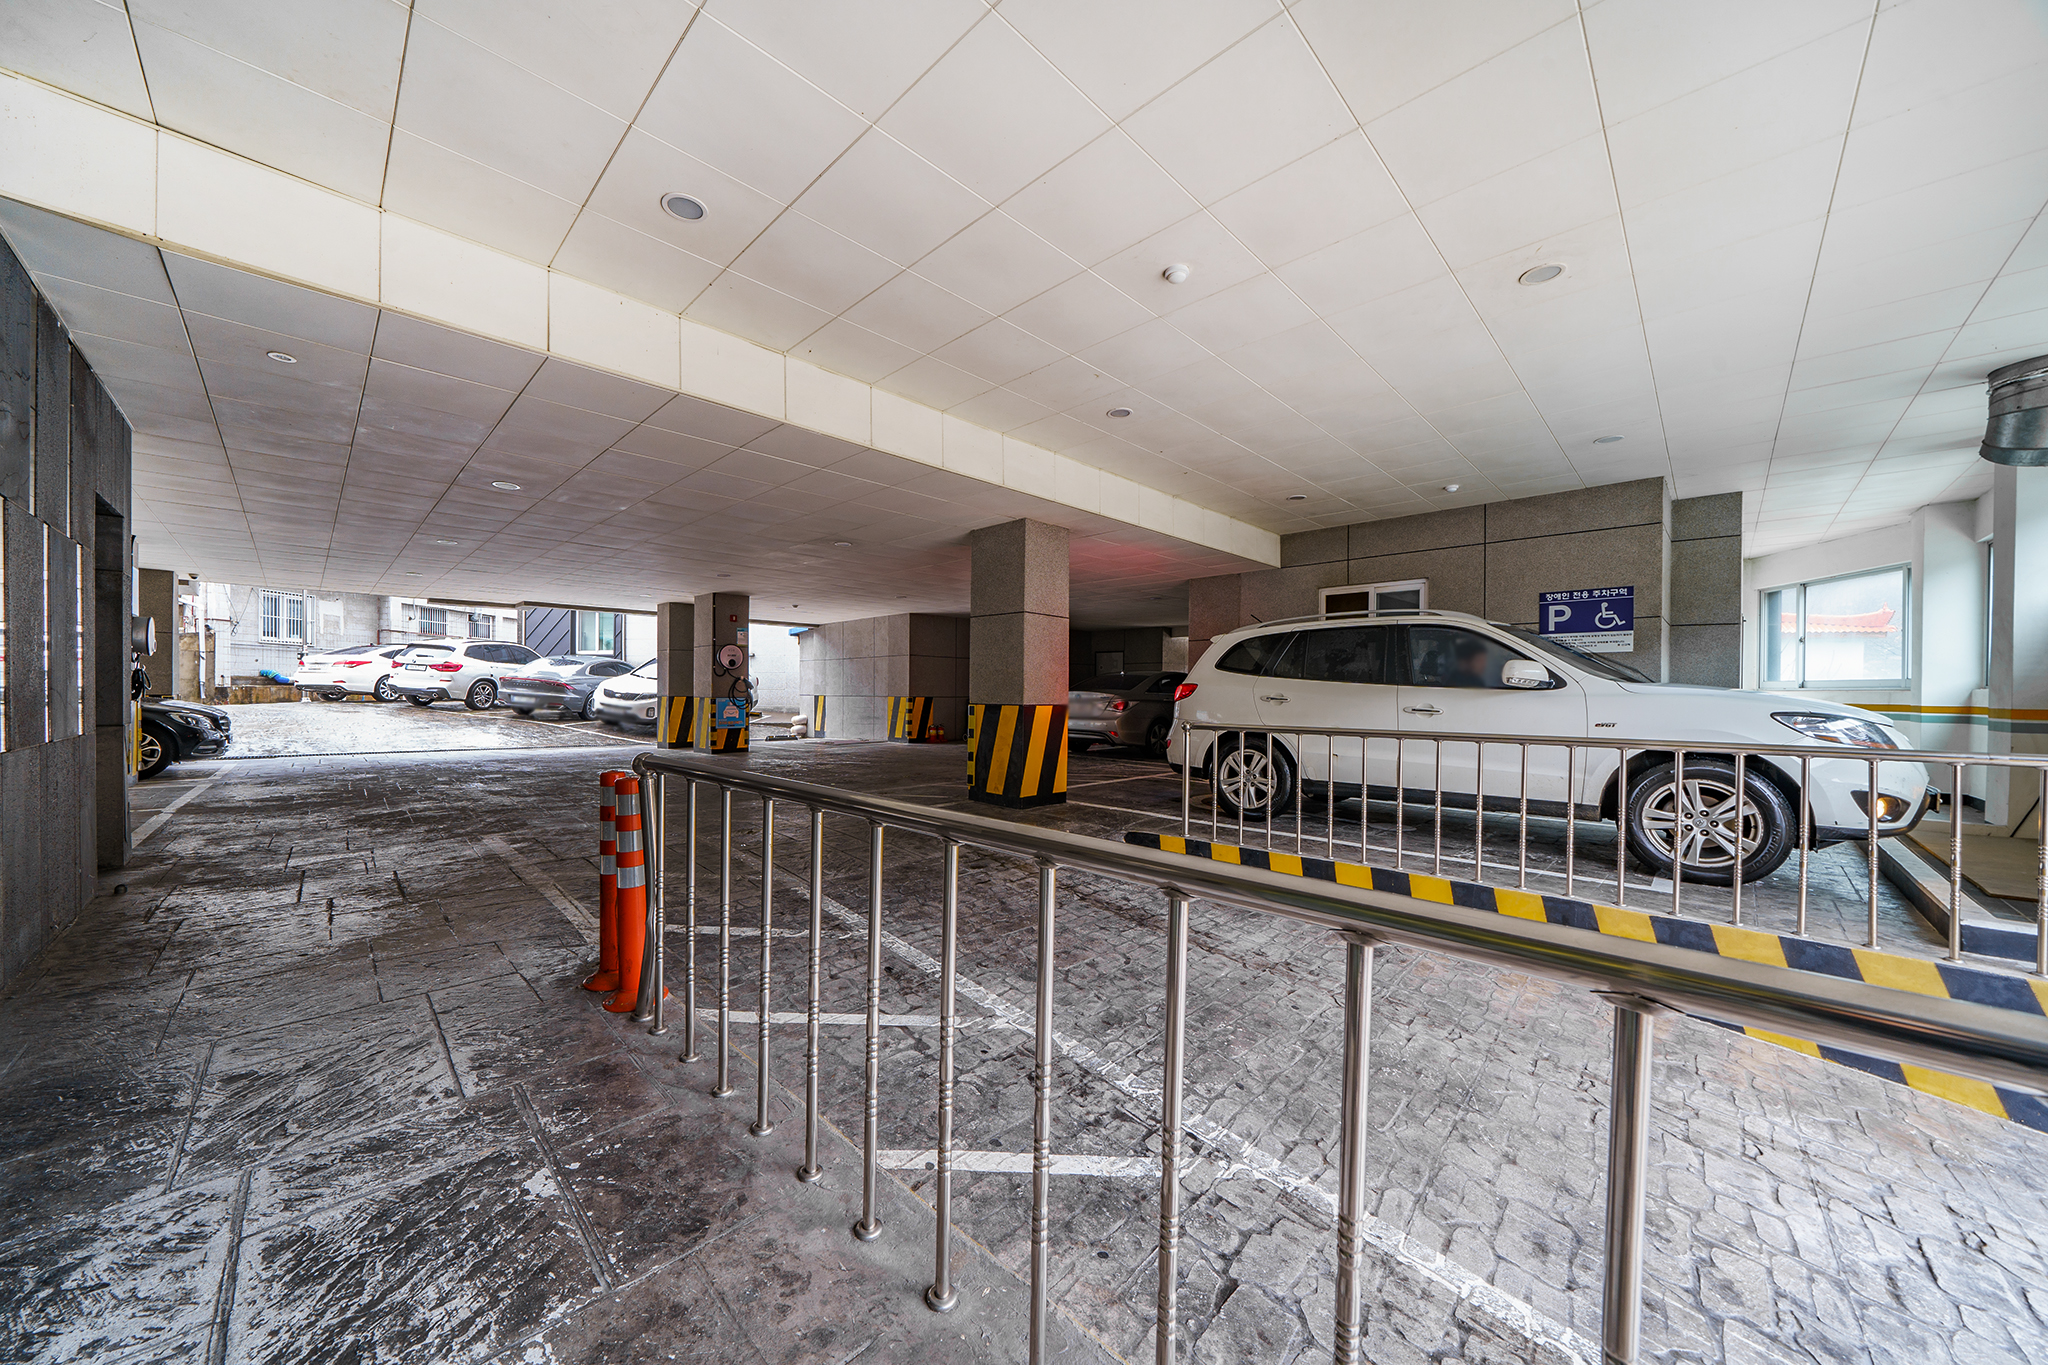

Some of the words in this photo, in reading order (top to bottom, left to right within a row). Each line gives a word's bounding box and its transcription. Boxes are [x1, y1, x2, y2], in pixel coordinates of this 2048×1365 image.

[1546, 592, 1570, 601] 장애인
[1573, 590, 1589, 599] 전용
[1592, 588, 1628, 598] 주차구역
[1549, 604, 1572, 631] P
